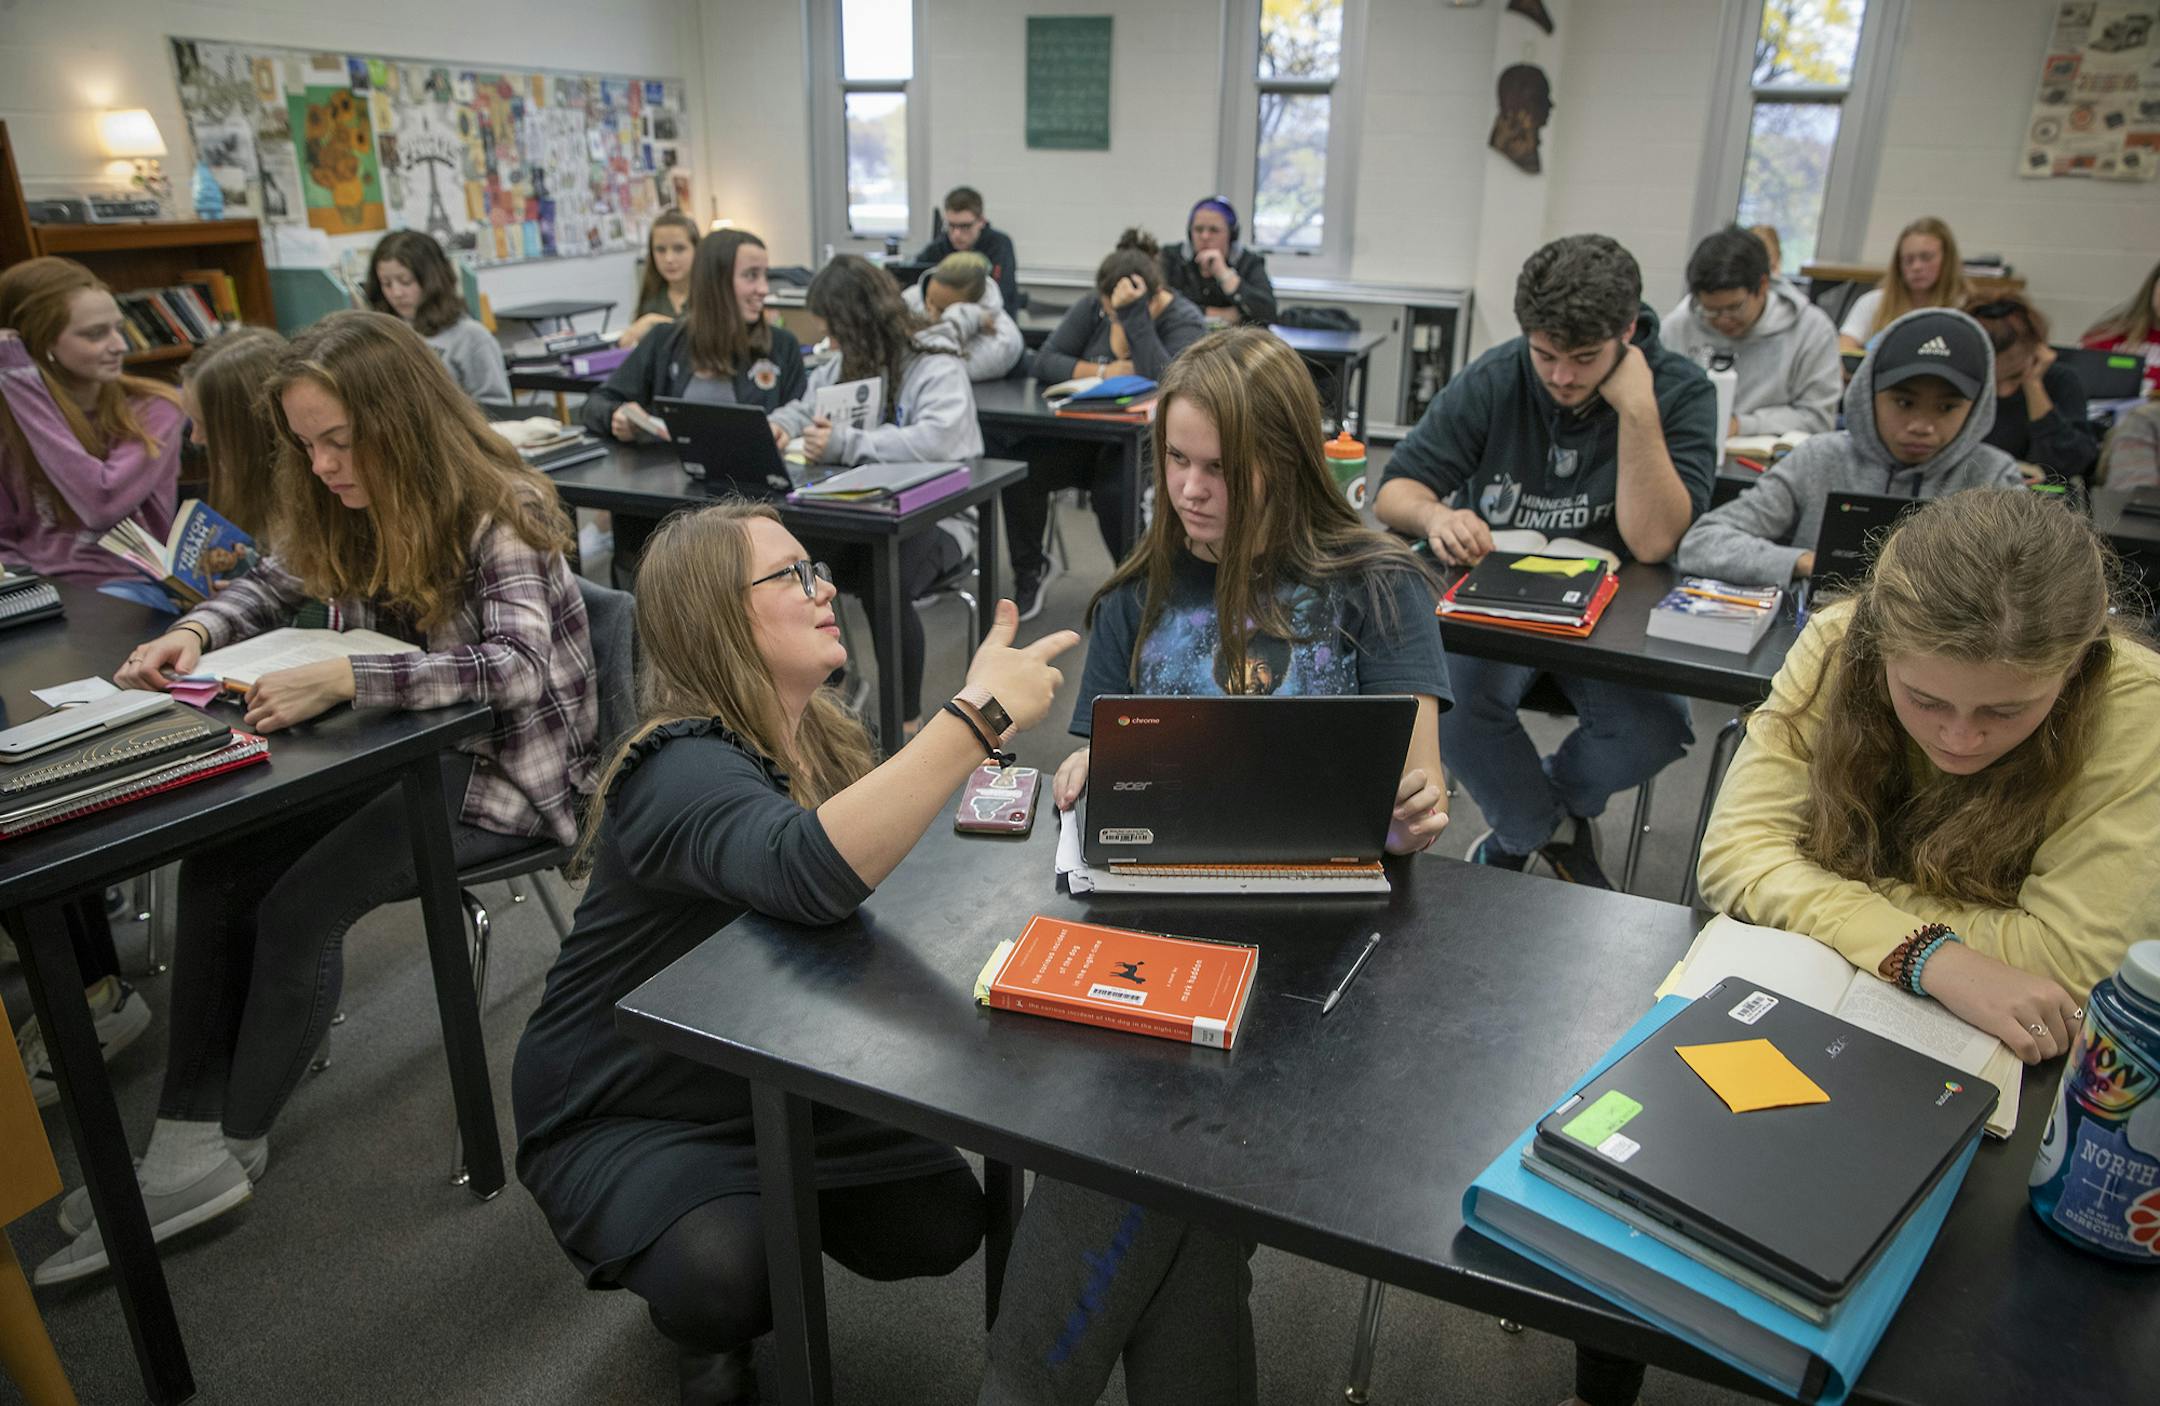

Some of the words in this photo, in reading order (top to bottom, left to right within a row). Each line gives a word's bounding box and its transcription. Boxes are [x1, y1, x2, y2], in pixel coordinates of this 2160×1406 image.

[1513, 507, 1590, 529] UNITED
[178, 511, 207, 571] TREVOR
[187, 525, 209, 568] NOAH
[1132, 717, 1160, 725] chrome
[1113, 782, 1153, 791] acer
[1039, 951, 1055, 974] curious
[1052, 929, 1068, 952] incident
[1069, 945, 1081, 957] dog
[1181, 985, 1193, 1002] mark
[1187, 960, 1203, 985] haddon
[1040, 1004, 1065, 1014] curious
[1067, 1009, 1094, 1019] incident
[1117, 1019, 1131, 1027] dog
[1140, 1022, 1152, 1030] the
[2080, 1139, 2160, 1187] NORTH
